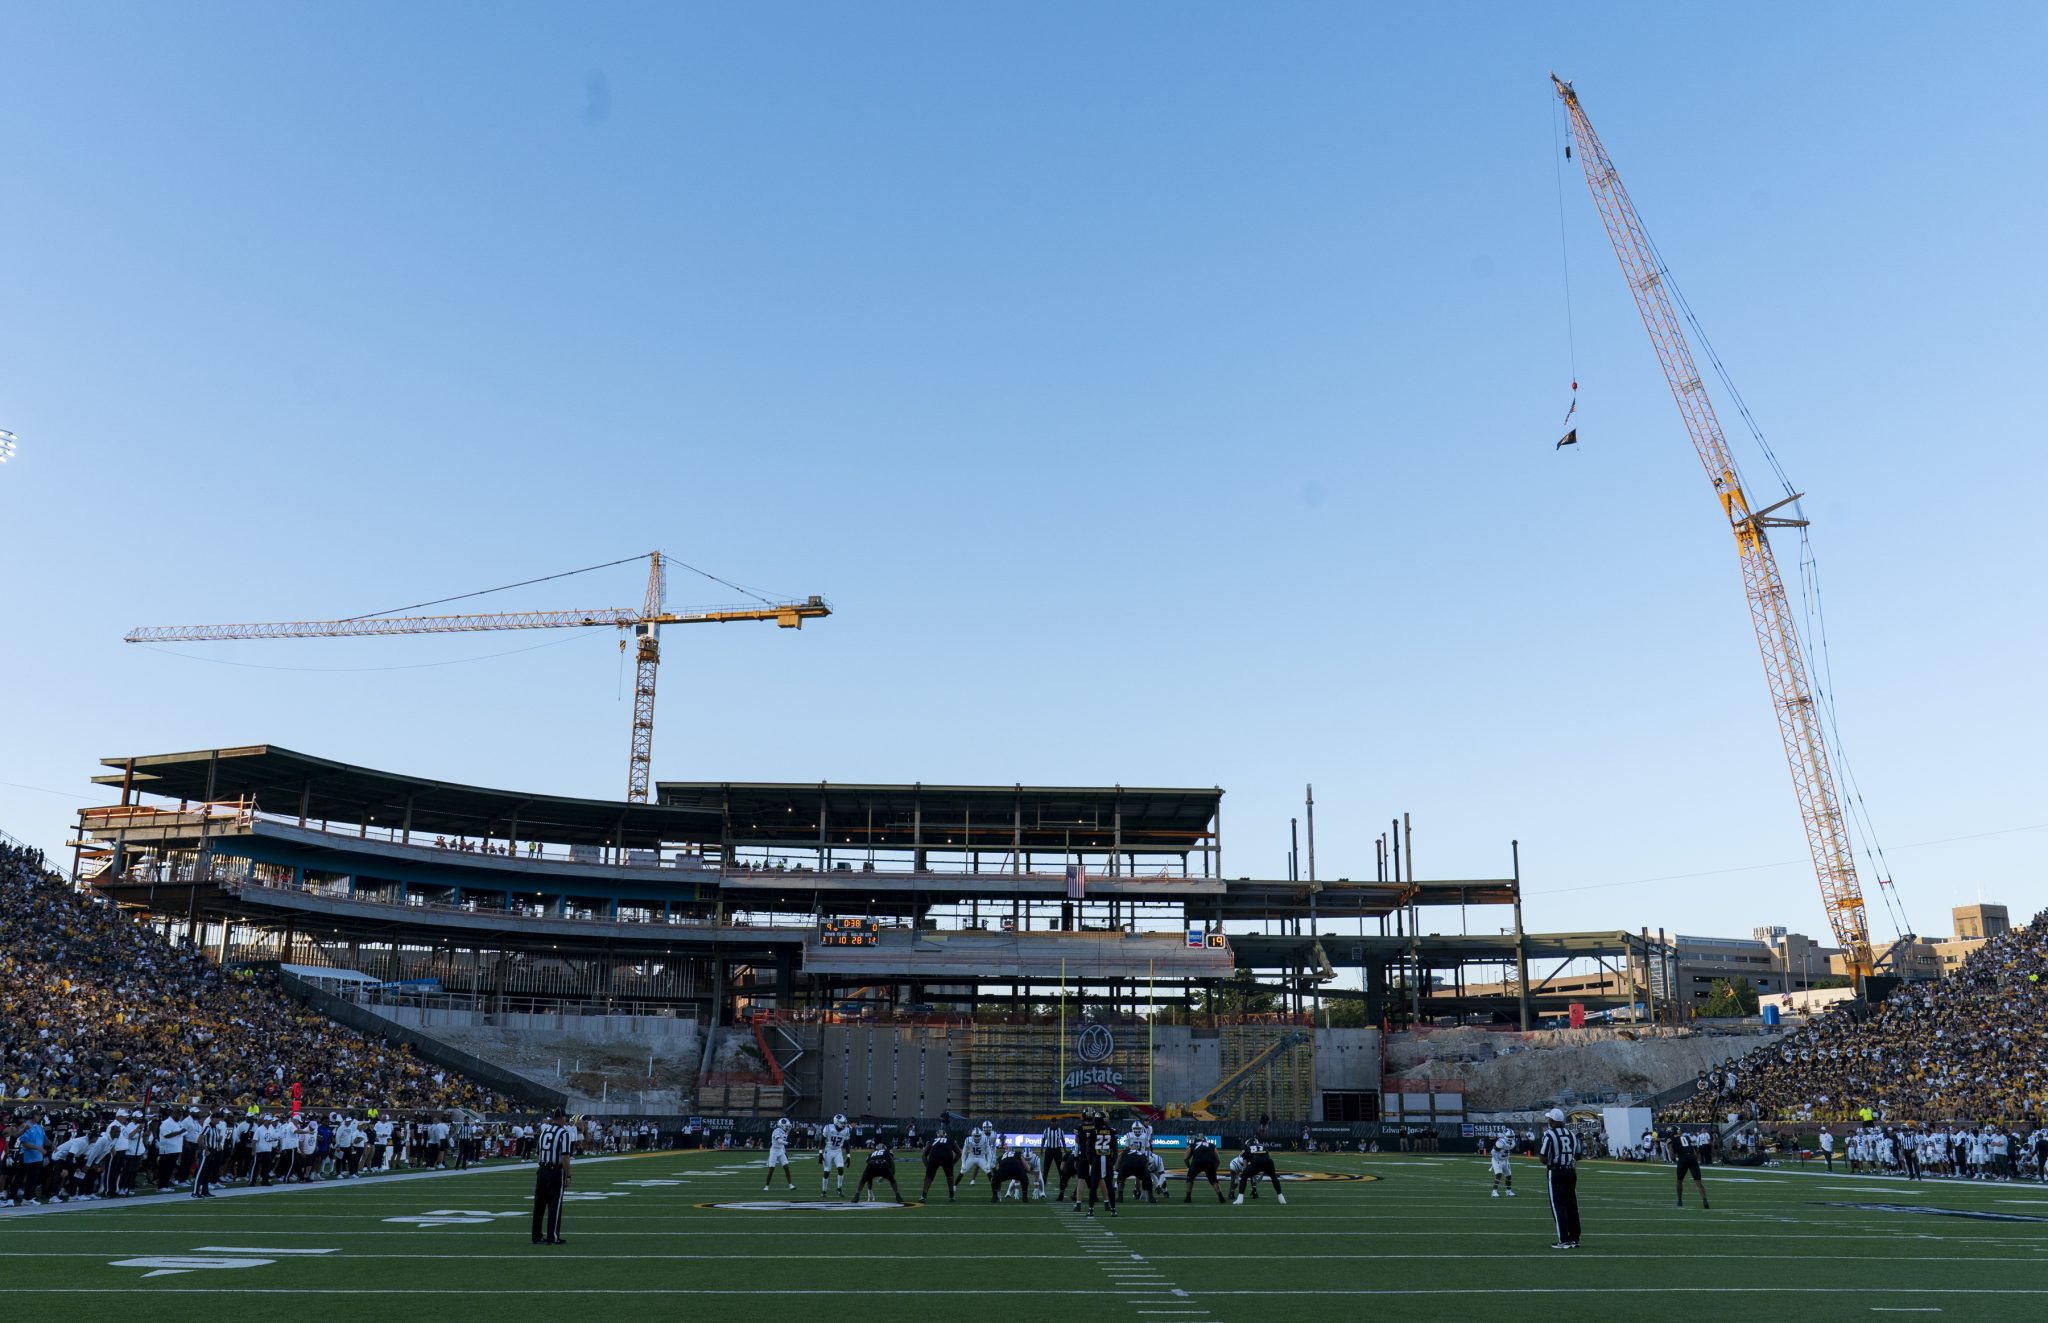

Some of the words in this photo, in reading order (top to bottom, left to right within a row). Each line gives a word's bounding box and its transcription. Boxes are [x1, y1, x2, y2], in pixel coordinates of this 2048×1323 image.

[843, 919, 861, 927] 0:38
[872, 923, 878, 932] 0
[838, 936, 847, 945] 10
[851, 936, 863, 945] 28
[1212, 936, 1223, 946] 19
[1063, 1067, 1123, 1088] Allstate
[542, 1132, 553, 1150] C
[831, 1136, 843, 1147] 42
[1095, 1134, 1111, 1150] 22
[1560, 1136, 1573, 1152] R
[1681, 1136, 1689, 1147] 0
[972, 1147, 982, 1156] 15
